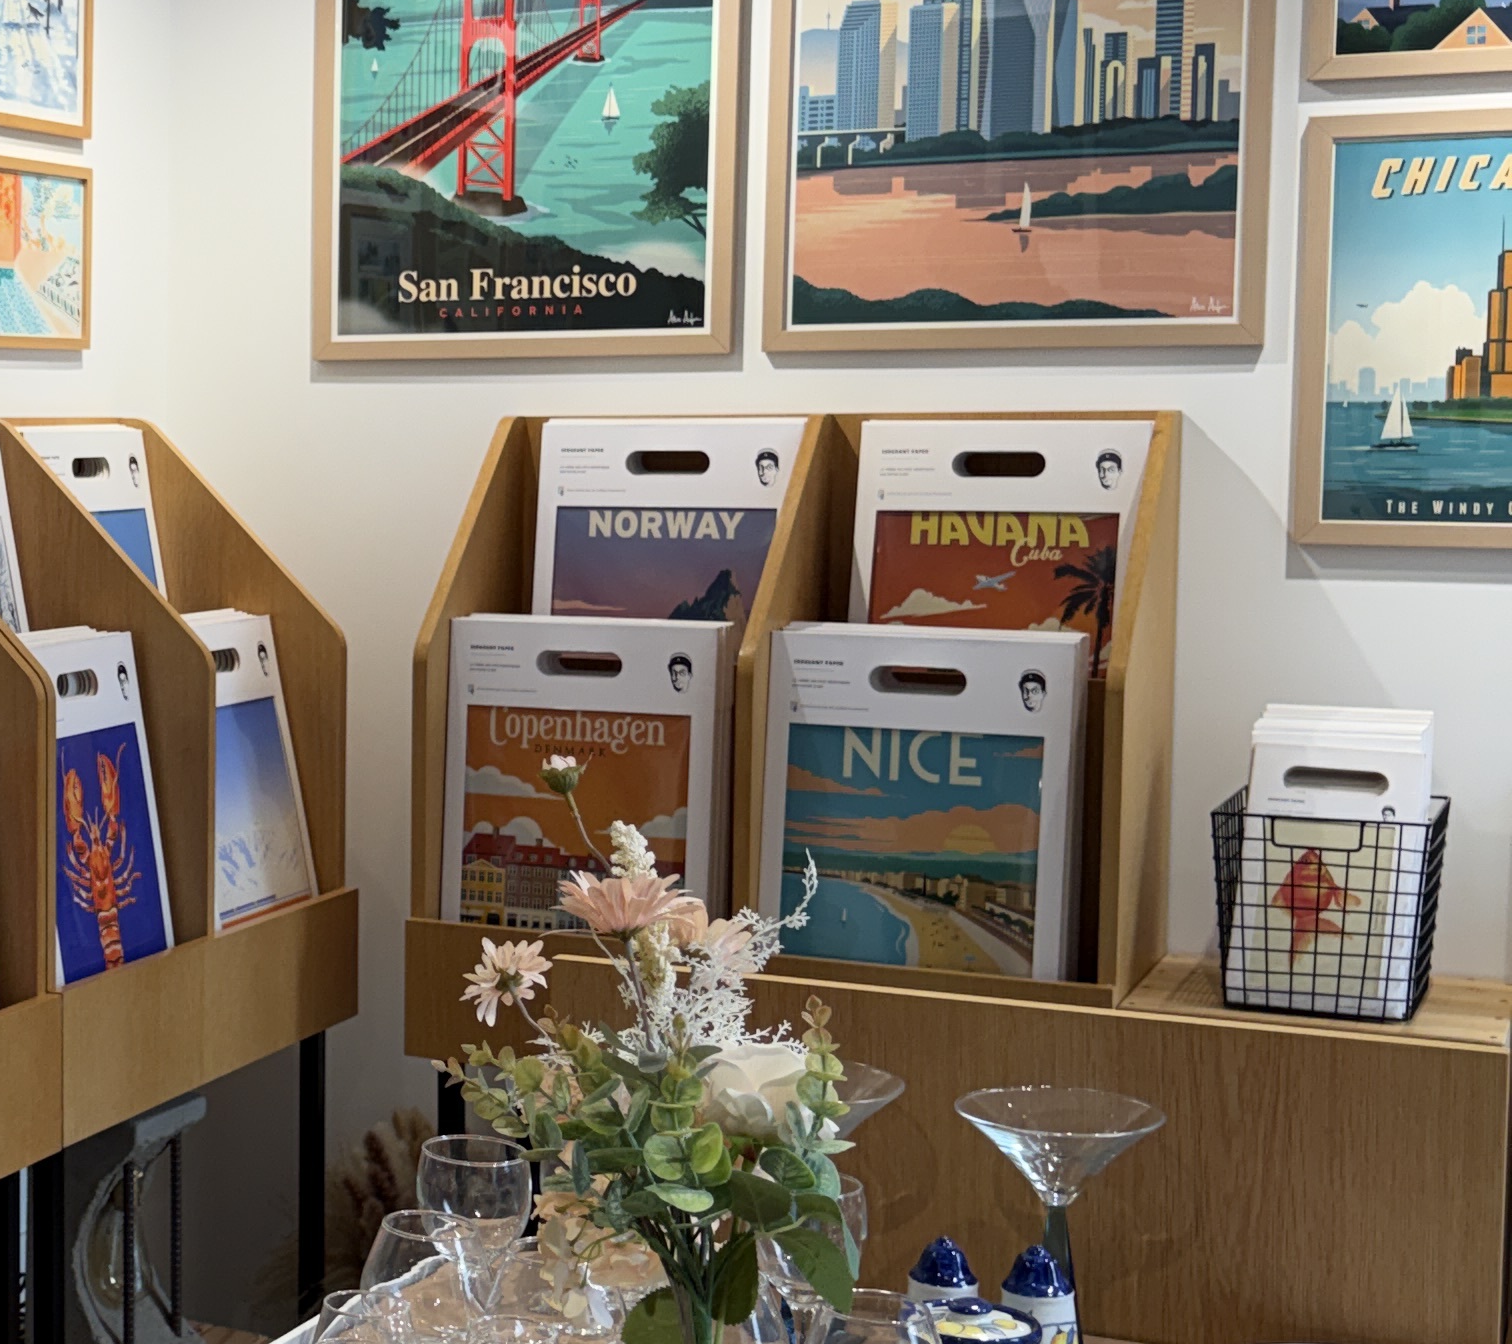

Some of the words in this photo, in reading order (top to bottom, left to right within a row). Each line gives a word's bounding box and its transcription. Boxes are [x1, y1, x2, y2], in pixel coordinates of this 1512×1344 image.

[398, 270, 459, 303] San
[469, 264, 637, 301] Francisco
[439, 304, 588, 319] CALIFORNIA
[1386, 499, 1419, 515] THE
[1432, 500, 1495, 516] WINDY
[589, 509, 745, 540] NORWAY
[910, 512, 1090, 548] HAVANA
[1009, 537, 1063, 566] Cuba
[489, 706, 666, 755] Copenhagen
[842, 726, 984, 787] NICE
